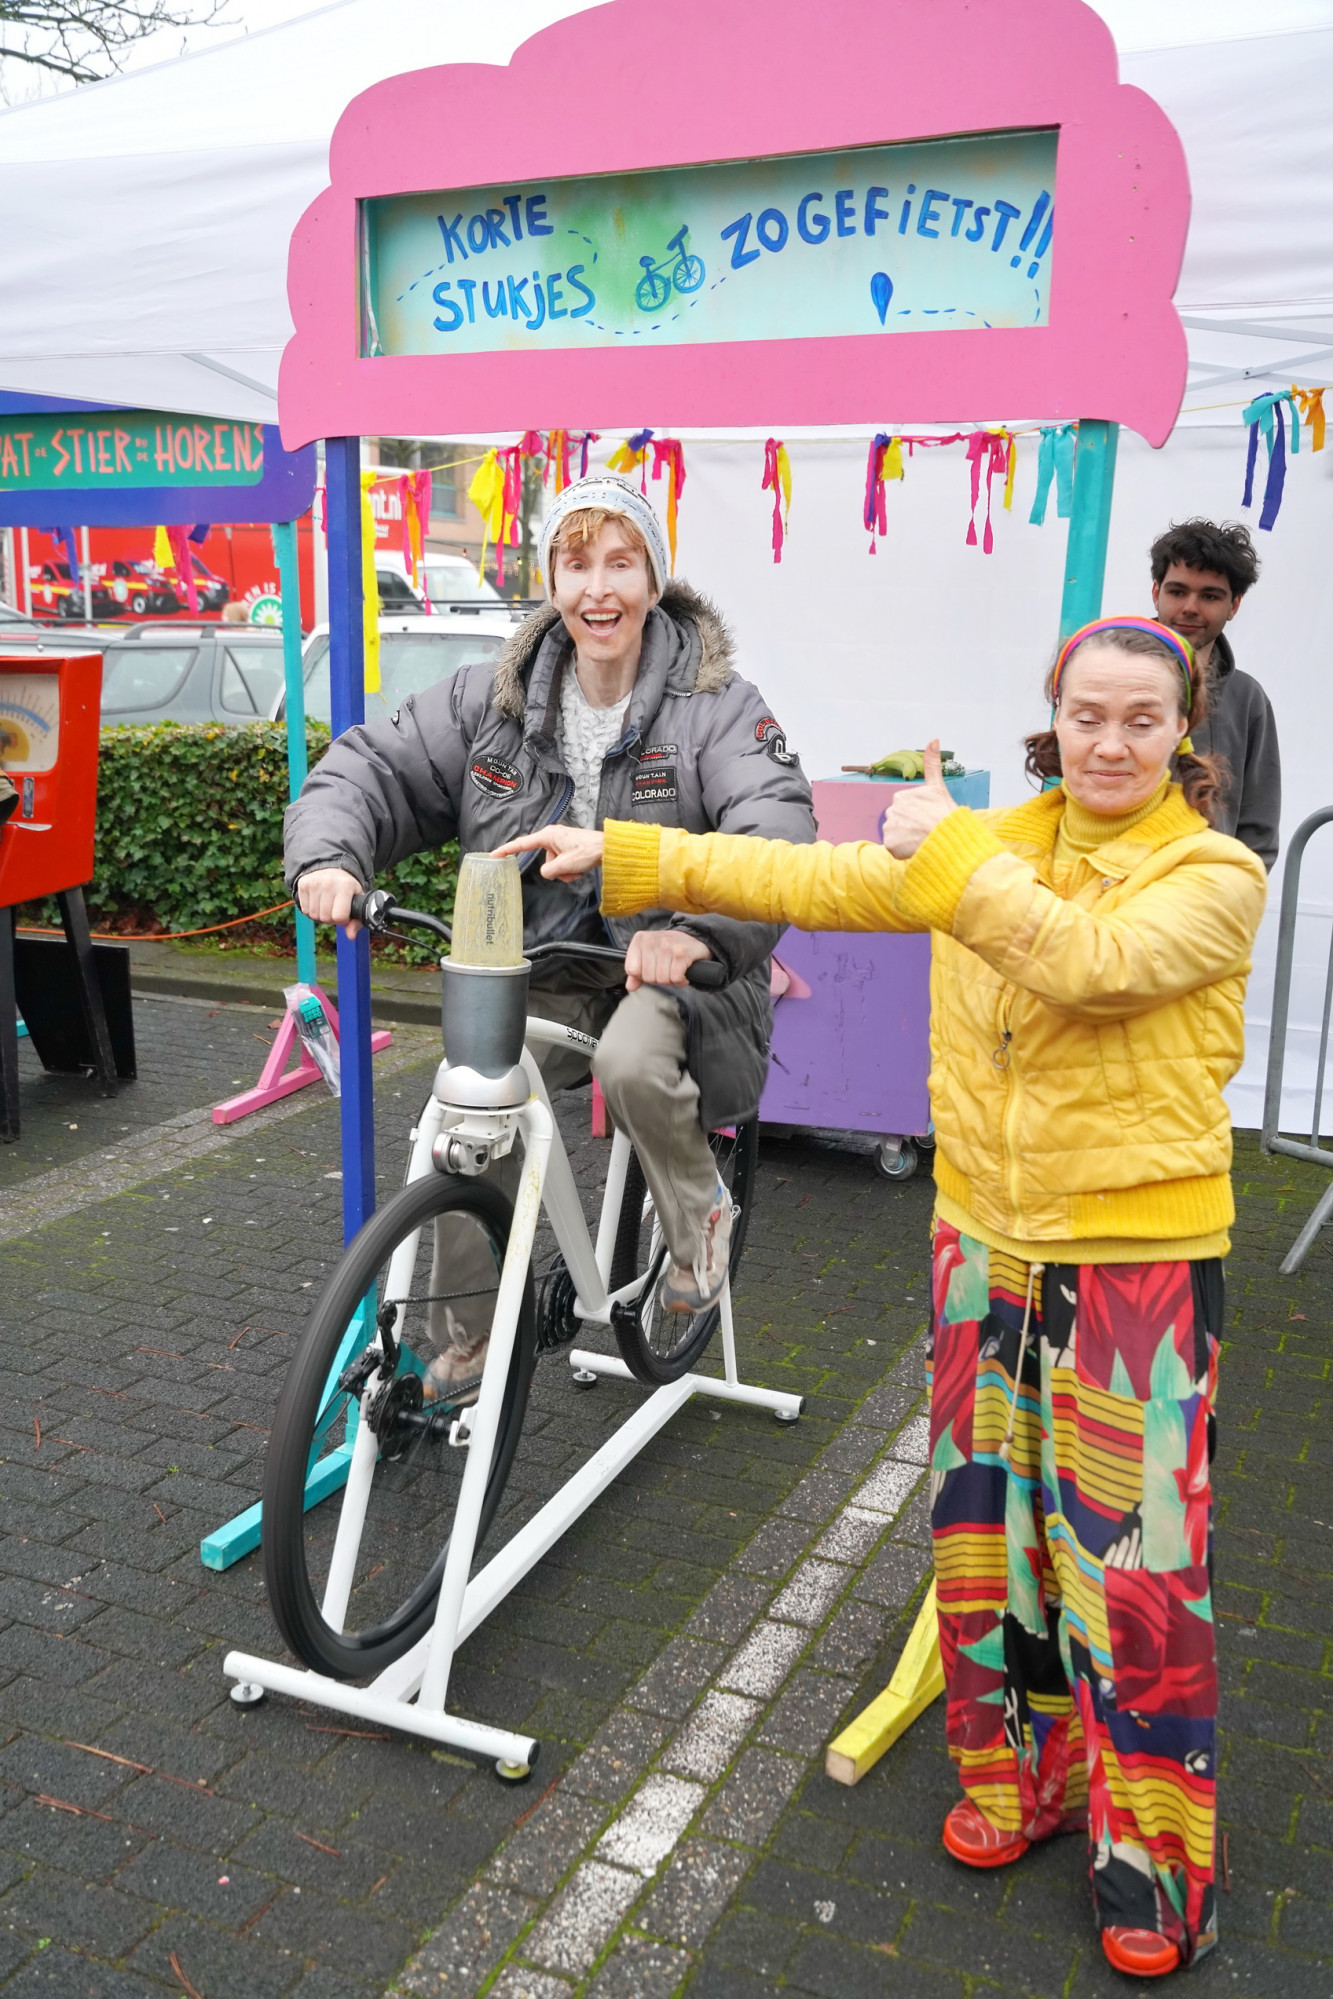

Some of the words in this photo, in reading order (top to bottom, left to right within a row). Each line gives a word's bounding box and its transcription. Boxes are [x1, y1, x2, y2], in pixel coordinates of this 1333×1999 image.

[437, 194, 554, 264] KORTE
[0, 432, 34, 478] AT
[51, 428, 133, 477] STIER
[154, 423, 264, 473] HORENS
[632, 787, 676, 802] COLORADO
[486, 893, 496, 945] nutribullet
